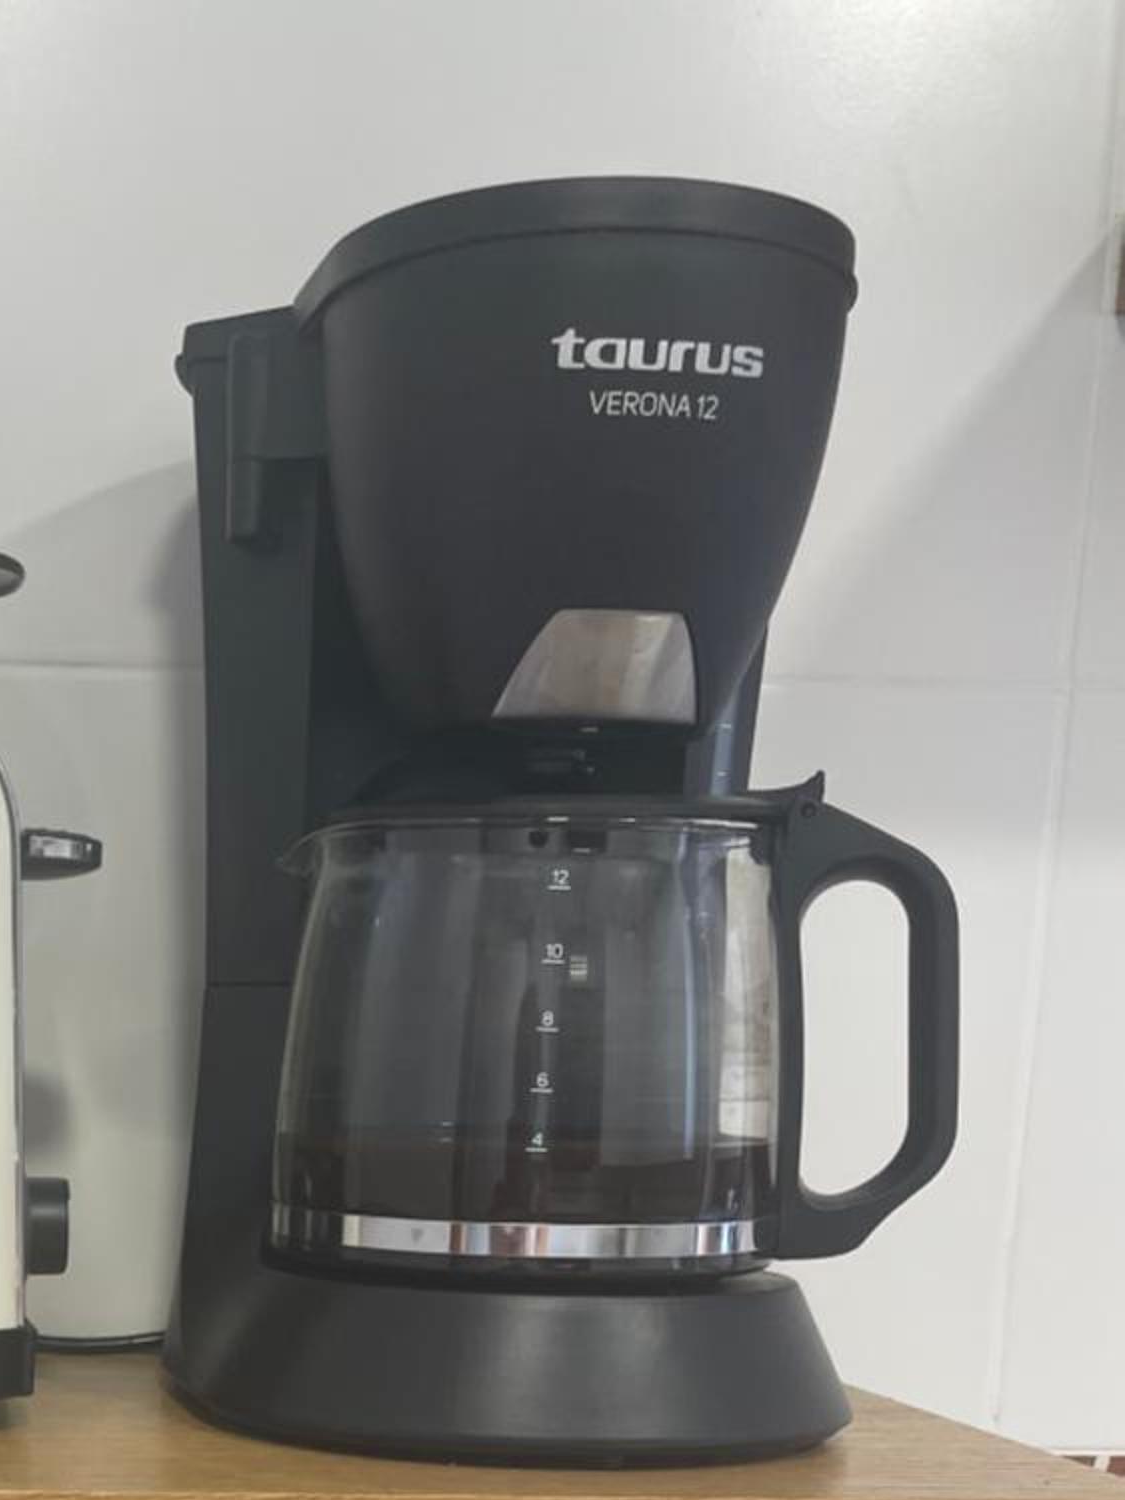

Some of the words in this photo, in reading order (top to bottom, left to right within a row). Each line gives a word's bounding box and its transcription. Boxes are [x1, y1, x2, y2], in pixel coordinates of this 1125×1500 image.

[551, 328, 764, 378] taurus
[589, 390, 691, 417] VERONA
[696, 395, 720, 419] 12
[551, 869, 569, 885] 12
[546, 944, 564, 959] 10
[542, 1010, 553, 1026] 8
[536, 1071, 549, 1087] 6
[531, 1132, 543, 1147] 4
